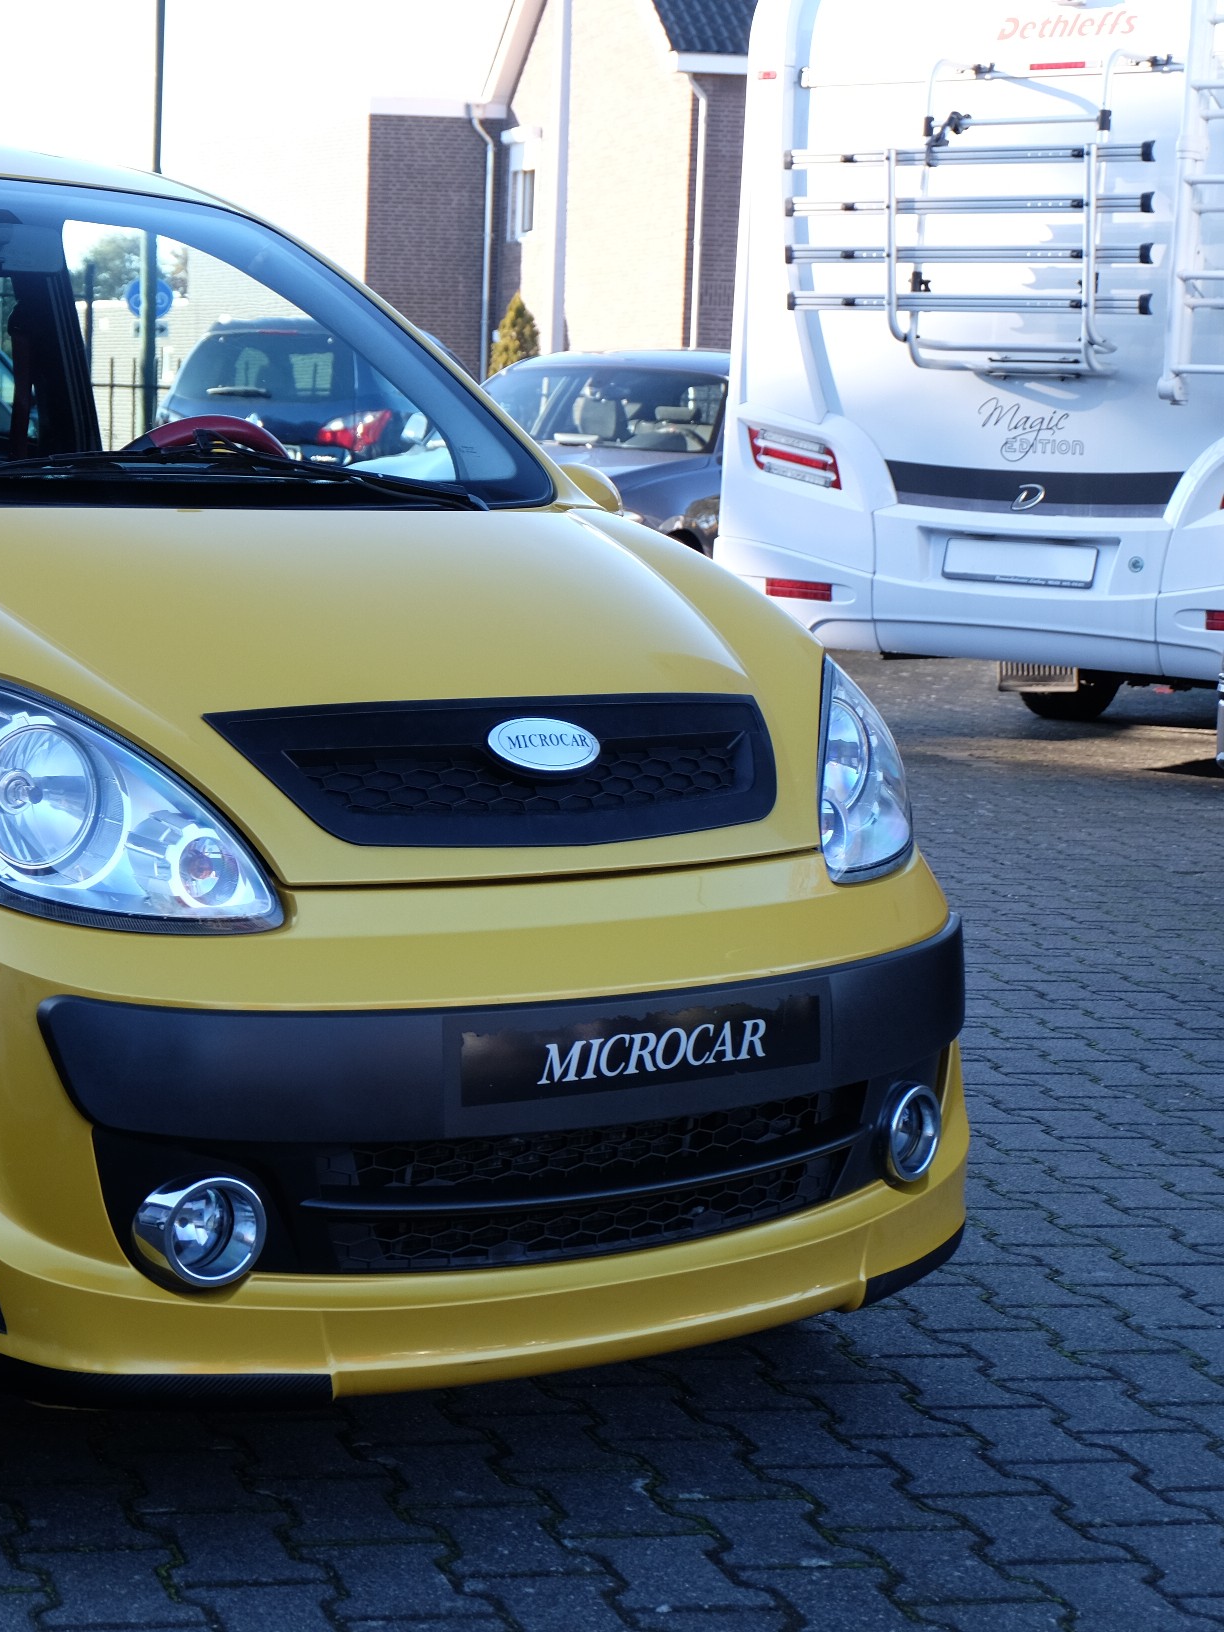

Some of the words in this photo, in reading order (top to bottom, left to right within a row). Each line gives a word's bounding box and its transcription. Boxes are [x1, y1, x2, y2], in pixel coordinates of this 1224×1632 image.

[997, 10, 1139, 41] Dethleffs
[978, 396, 1070, 463] Magic
[507, 732, 591, 750] MICROCAR
[536, 1018, 767, 1086] MICROCAR
